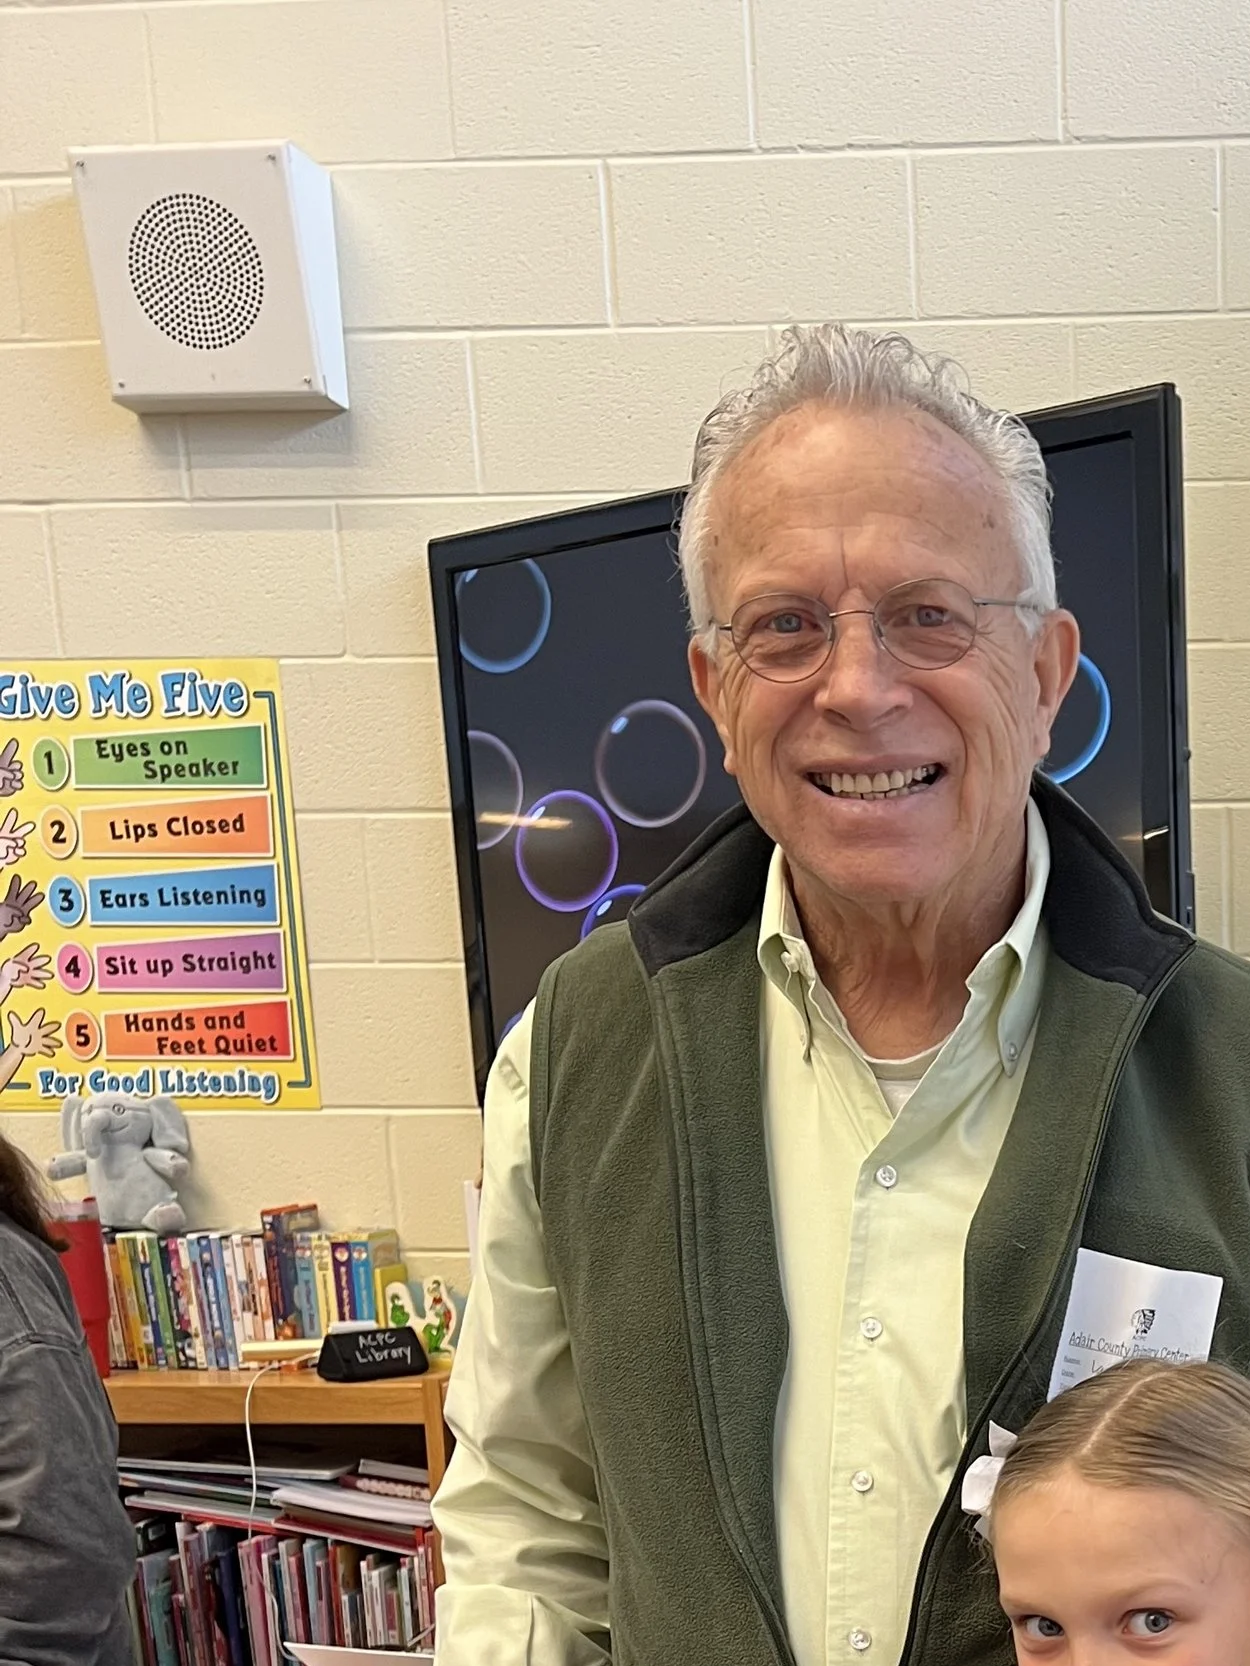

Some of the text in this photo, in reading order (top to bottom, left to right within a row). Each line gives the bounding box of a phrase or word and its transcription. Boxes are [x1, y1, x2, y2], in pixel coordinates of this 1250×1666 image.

[0, 671, 248, 716] Give Me Five
[43, 750, 55, 775] 1
[96, 738, 189, 763] Eyes on
[144, 758, 240, 784] Speaker
[50, 821, 67, 844] 2
[109, 813, 245, 842] Lips Closed
[59, 888, 75, 913] 3
[99, 885, 267, 909] Ears Listening
[65, 956, 82, 978] 4
[105, 951, 278, 978] Sit up Straight
[125, 1010, 246, 1033] Hands and
[75, 1025, 91, 1047] 5
[156, 1035, 279, 1056] Feet Quiet
[39, 1069, 279, 1098] For Good Listening
[355, 1346, 411, 1365] Library
[1069, 1332, 1096, 1350] Adair
[1098, 1338, 1130, 1359] County
[1161, 1346, 1190, 1363] Center
